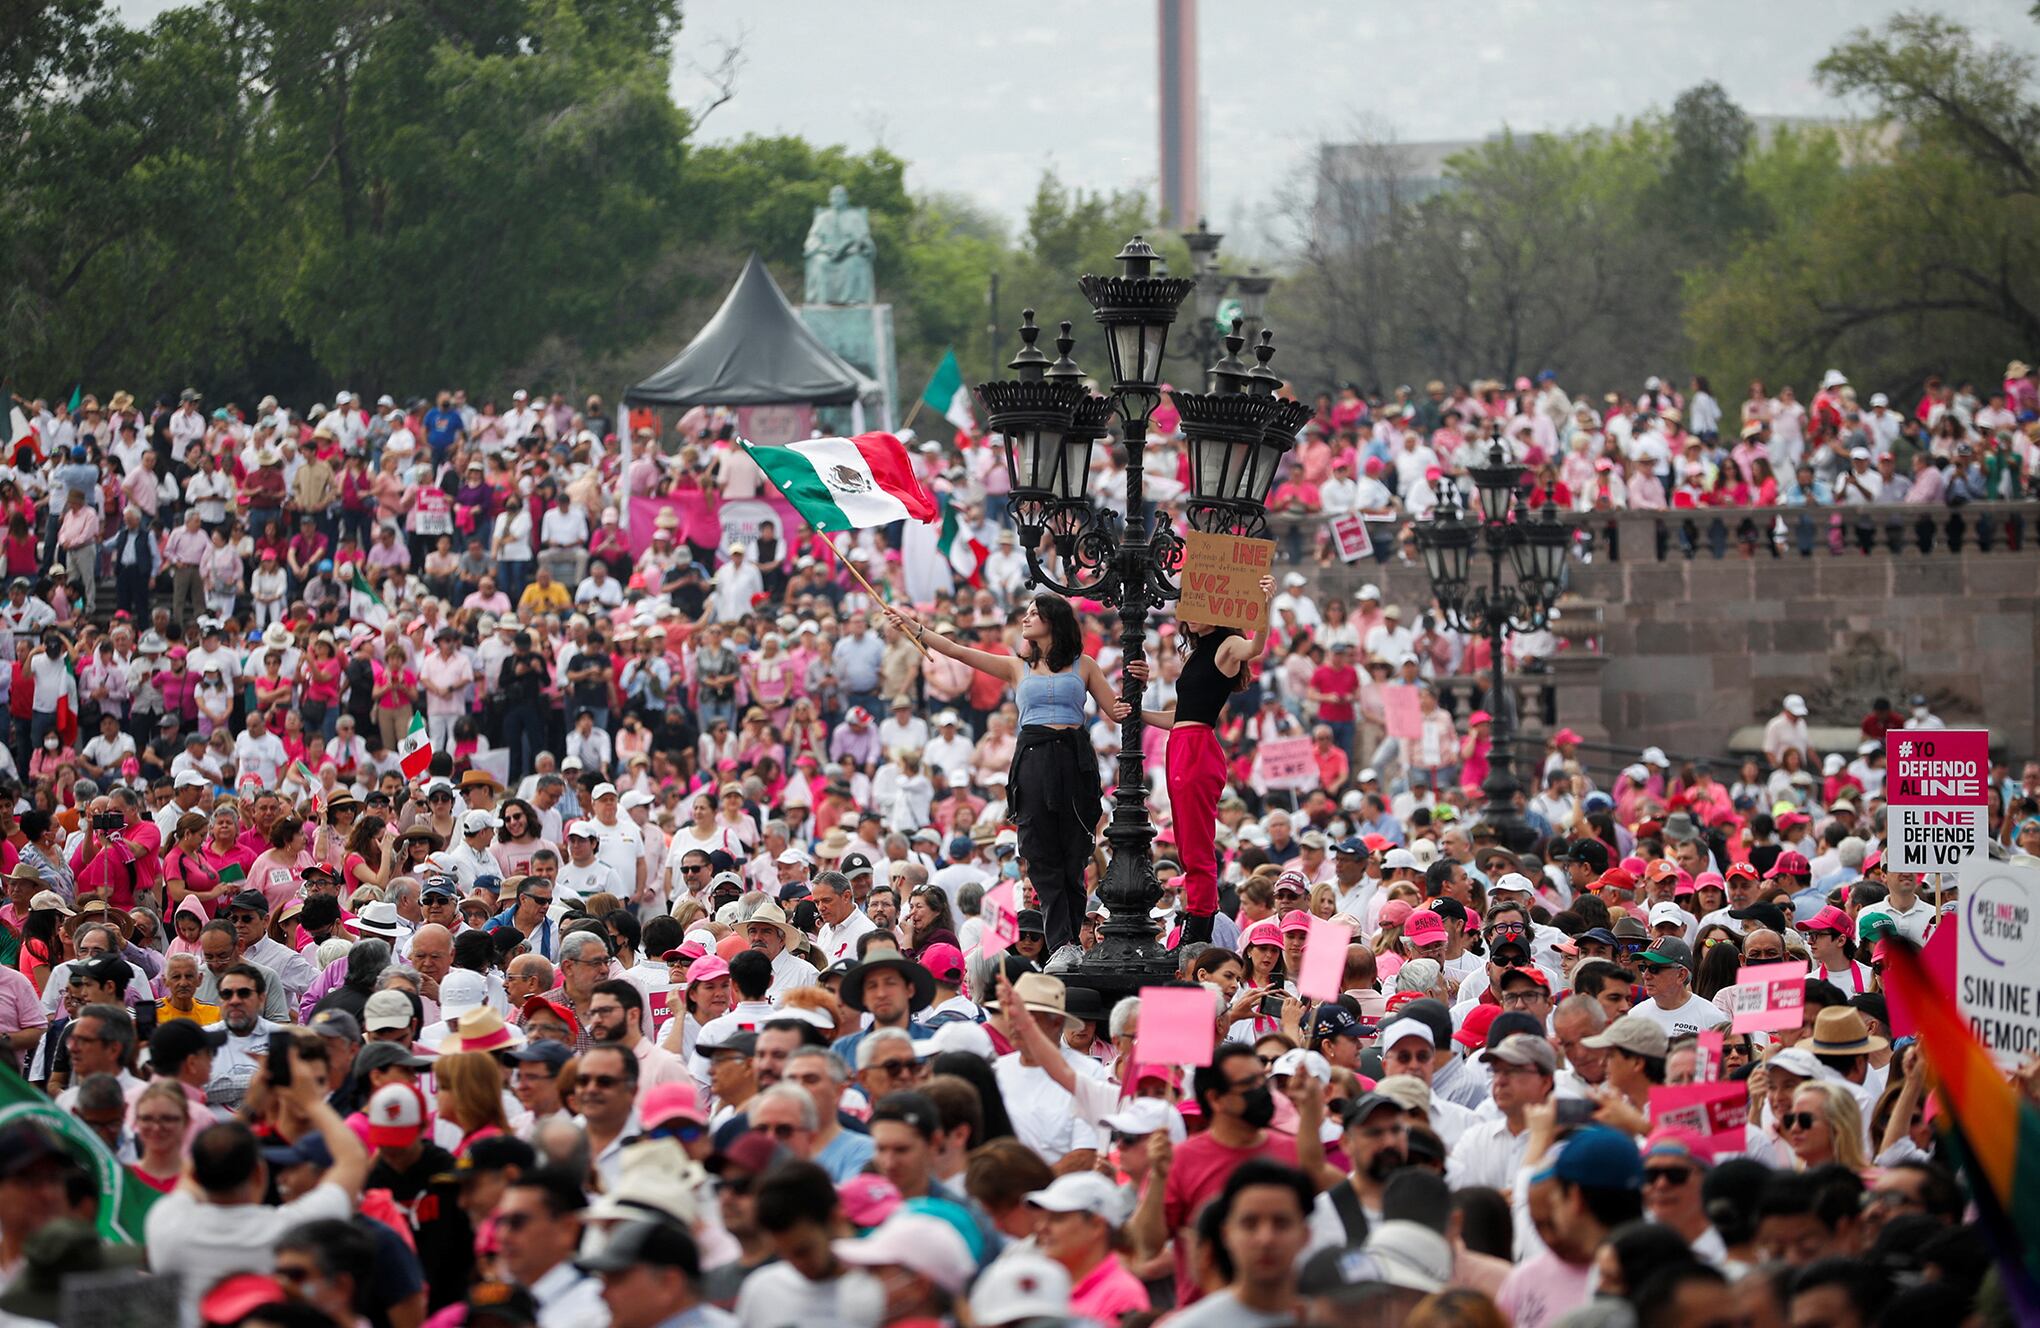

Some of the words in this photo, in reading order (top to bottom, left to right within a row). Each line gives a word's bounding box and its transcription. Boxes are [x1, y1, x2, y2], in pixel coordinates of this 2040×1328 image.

[1232, 541, 1268, 567] INE
[1189, 571, 1231, 595] VOZ
[1208, 594, 1260, 622] VOTO
[1898, 741, 1936, 758] #YO
[1898, 760, 1978, 778] DEFIENDO
[1903, 811, 1920, 825] EL
[1923, 811, 1975, 825] INE
[1904, 828, 1975, 843] DEFIENDE
[1904, 845, 1927, 865] MI
[1997, 921, 2024, 942] TOCA
[1963, 974, 1995, 1010] SIN
[1999, 982, 2032, 1016] INE
[1673, 1022, 1699, 1032] PODER
[1969, 1015, 2040, 1056] DEMOC
